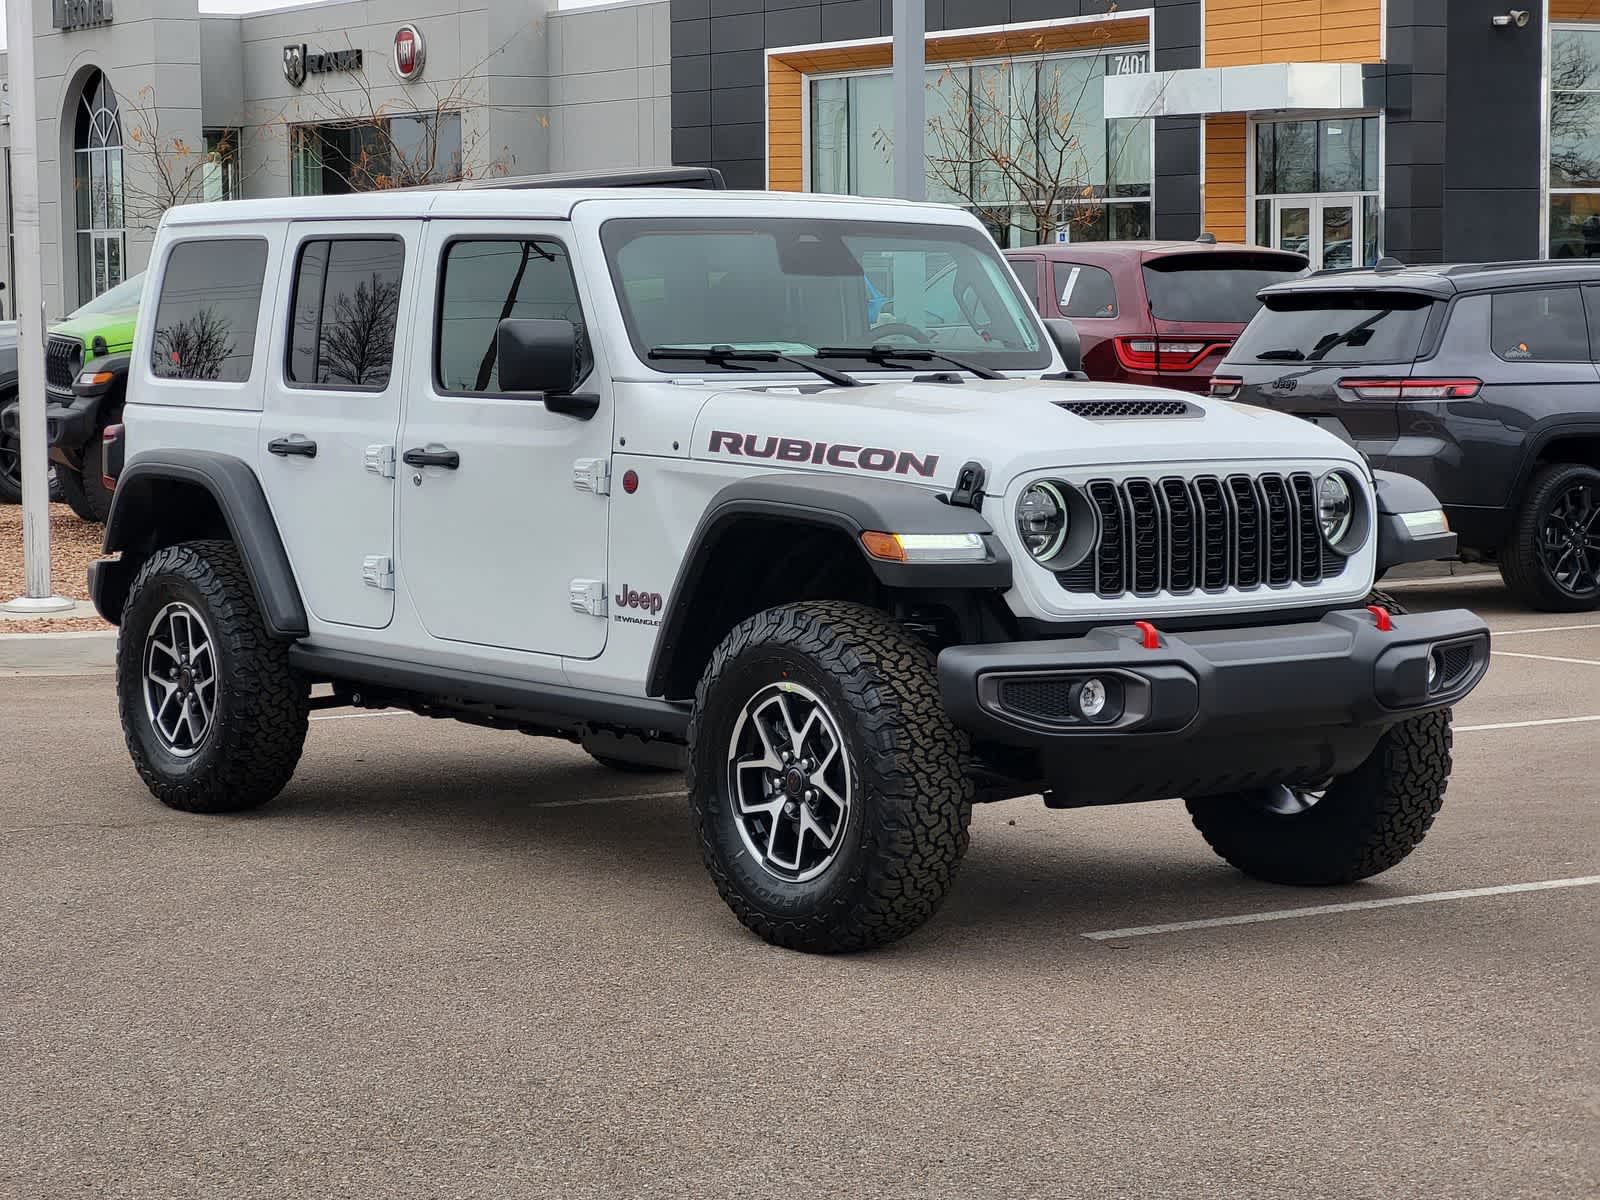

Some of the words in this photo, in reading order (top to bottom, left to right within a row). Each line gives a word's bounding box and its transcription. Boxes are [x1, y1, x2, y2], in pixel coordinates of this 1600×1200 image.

[306, 49, 362, 73] RAM
[1114, 54, 1146, 76] 7401
[1271, 377, 1297, 391] Jeep
[708, 430, 940, 477] RUBICON
[615, 583, 663, 616] Jeep
